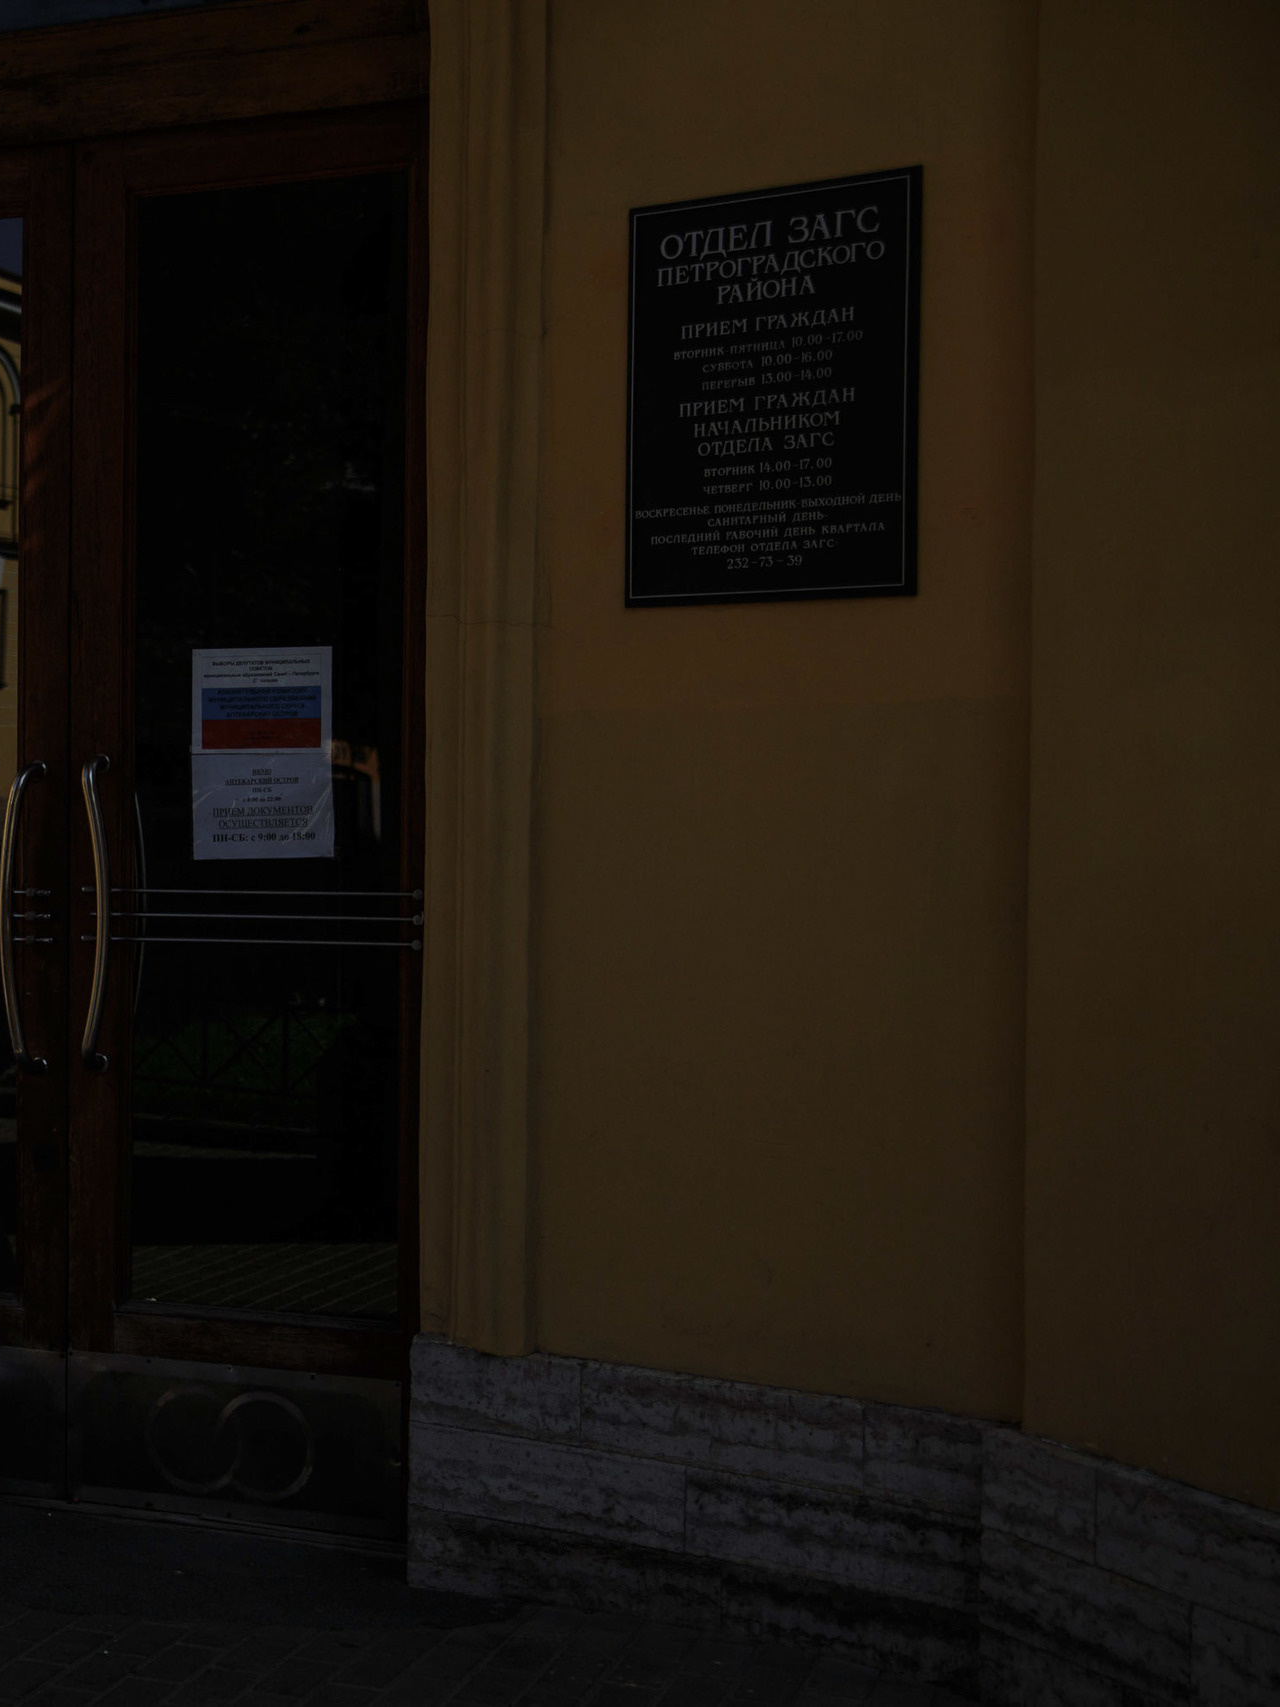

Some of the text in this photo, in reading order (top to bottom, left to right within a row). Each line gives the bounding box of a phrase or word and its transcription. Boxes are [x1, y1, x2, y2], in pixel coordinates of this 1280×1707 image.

[659, 205, 881, 261] ОТДЕЛ ЗАГС
[656, 240, 886, 288] ПЕТРОГРАДСКОГО
[716, 274, 816, 305] РАЙОНА
[680, 306, 855, 340] ПРИЕМ ГРАЖДАН
[702, 359, 754, 373] СУББОТА
[701, 376, 756, 391] ПЕРЕРЫВ
[679, 387, 856, 418] ПРИЕМ ГРАЖДАН
[693, 410, 841, 438] НАЧАЛЬНИКОМ
[697, 431, 835, 458] ОТДЕЛА ЗАГС
[703, 464, 756, 478] ВТОРНИК
[702, 482, 754, 495] ЧЕТВЕРГ
[635, 504, 710, 519] ВОСКРЕСЕНЬЕ
[868, 492, 902, 504] ДЕНЬ
[707, 512, 787, 528] САНИТАРНЫЙ
[650, 521, 886, 547] ПОСЛЕДНИЙ РАБОЧИЙ ДЕНЬ КВАРТАЛА
[691, 543, 747, 556] ТЕЛЕФОН
[750, 541, 799, 552] ОТДЕЛА
[212, 805, 314, 818] ПРИЕМ ДОКУМЕНТОВ
[218, 817, 308, 830] ОСУЩЕСТВЛЯЕТСЯ
[212, 833, 249, 843] ПН-СБ:
